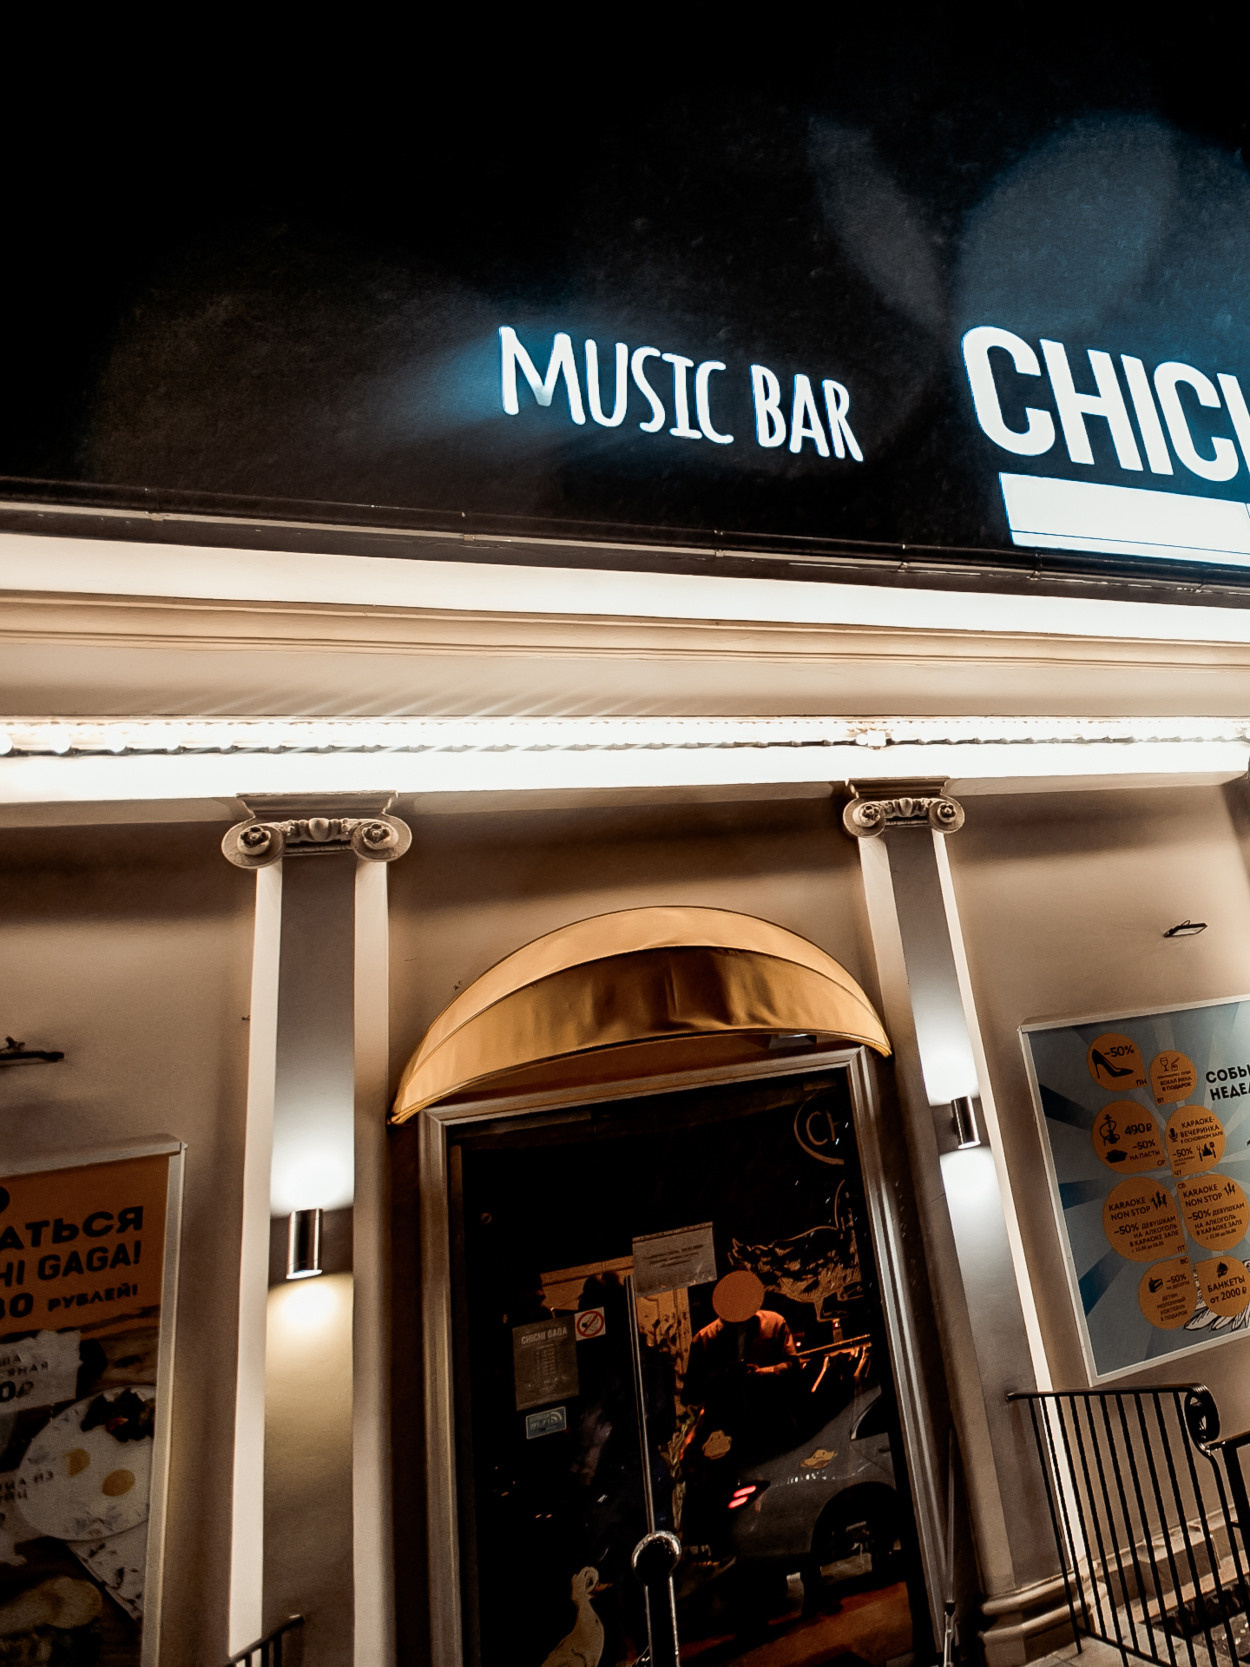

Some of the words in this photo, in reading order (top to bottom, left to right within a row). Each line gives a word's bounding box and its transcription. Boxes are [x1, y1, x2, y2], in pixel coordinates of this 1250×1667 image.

[499, 325, 734, 444] MUSIC
[750, 364, 864, 462] BAR
[1103, 1044, 1135, 1058] -50%
[1136, 1078, 1148, 1087] ПН
[1180, 1124, 1220, 1138] ВЕЧЕРИНКА
[1132, 1139, 1156, 1150] -50%
[1140, 1149, 1161, 1159] ПАСТЫ
[1172, 1147, 1193, 1158] -50%
[1183, 1184, 1219, 1198] KARAOKE
[1108, 1196, 1146, 1211] KARAOKE
[1185, 1198, 1203, 1208] NON
[1204, 1192, 1223, 1203] STOP
[1111, 1211, 1130, 1221] NON
[1131, 1205, 1151, 1216] STOP
[1187, 1208, 1211, 1221] -50%
[1212, 1202, 1245, 1217] ДЕВУШКАМ
[1114, 1222, 1139, 1235] -50%
[1142, 1216, 1176, 1230] ДЕВУШКАМ
[1205, 1214, 1237, 1226] АЛКОГОЛЬ
[1228, 1219, 1243, 1228] ЗАЛЕ
[1145, 1223, 1178, 1236] АЛКОГОЛЬ
[1164, 1230, 1179, 1239] ЗАЛЕ
[1176, 1244, 1186, 1252] ПТ
[38, 1240, 142, 1281] GAGA!
[1166, 1273, 1187, 1284] -50%
[1207, 1275, 1246, 1293] БАНКЕТЫ
[48, 1283, 138, 1312] РУБЛЕЙ!
[1220, 1288, 1241, 1301] 2000
